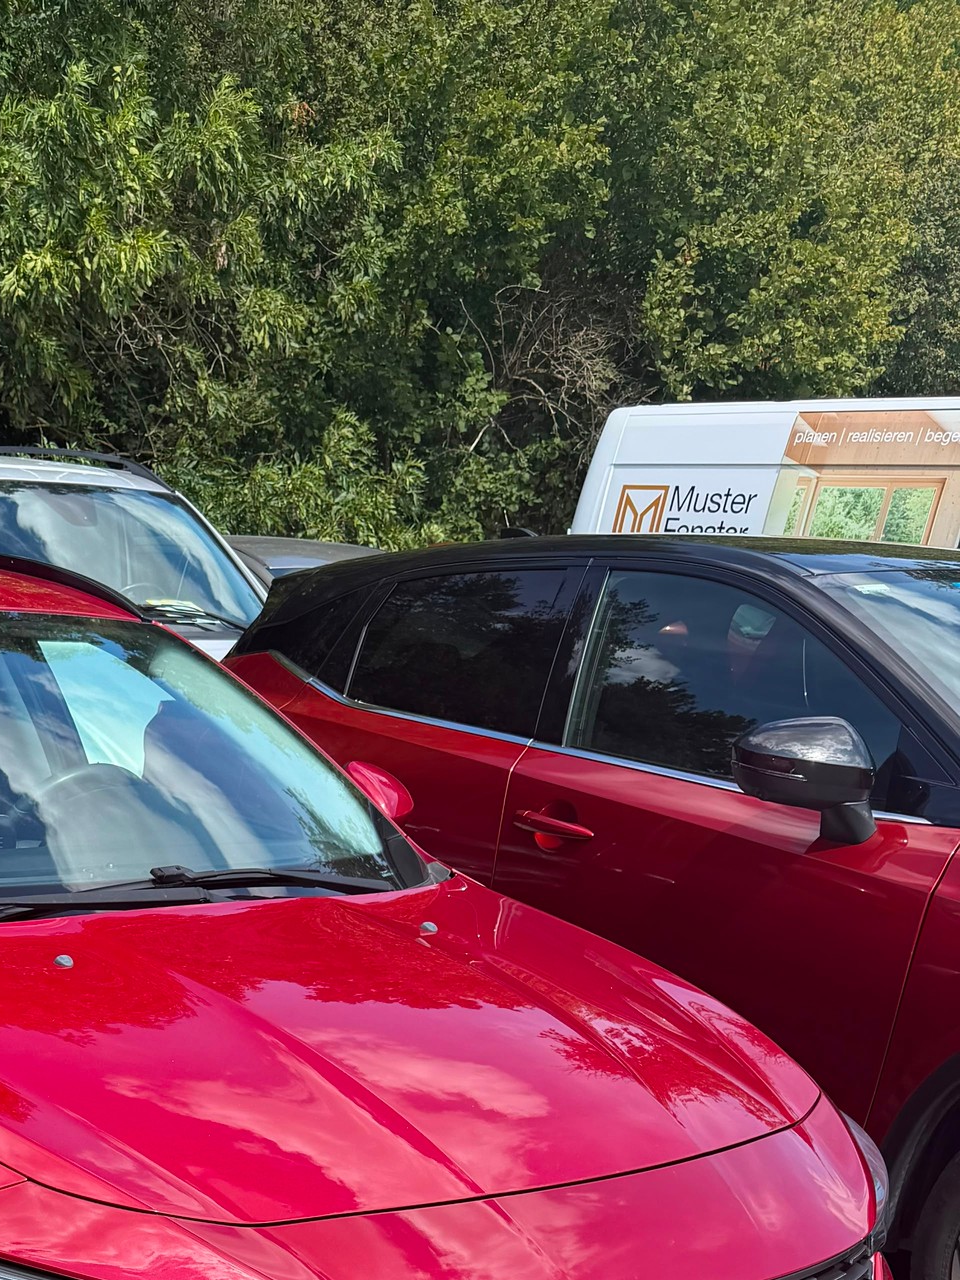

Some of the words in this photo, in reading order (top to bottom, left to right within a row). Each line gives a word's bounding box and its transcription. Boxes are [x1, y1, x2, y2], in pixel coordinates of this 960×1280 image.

[793, 429, 837, 446] planen
[846, 428, 914, 443] realisieren
[924, 428, 960, 446] bege
[669, 485, 758, 514] Muster
